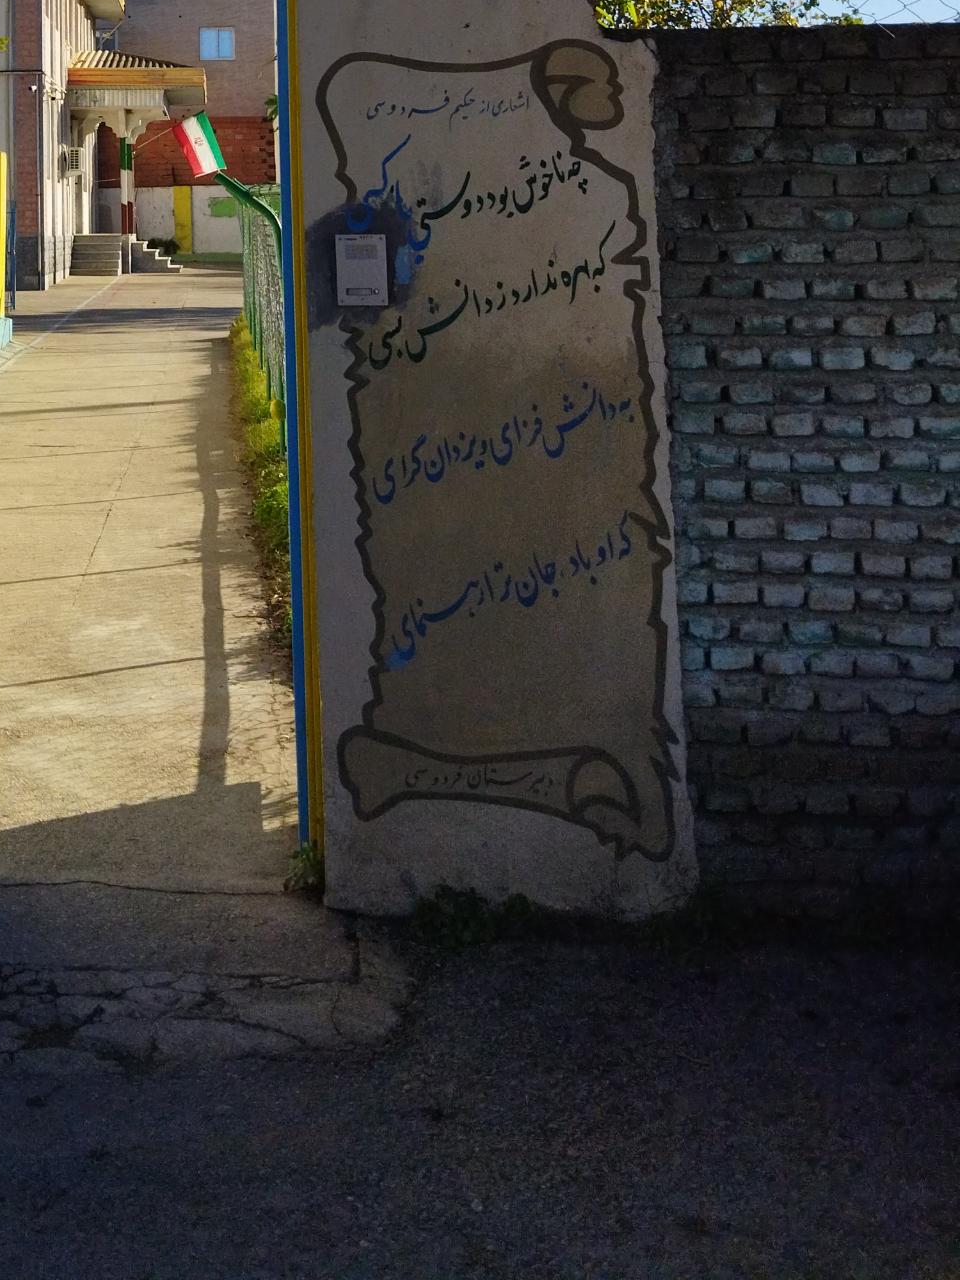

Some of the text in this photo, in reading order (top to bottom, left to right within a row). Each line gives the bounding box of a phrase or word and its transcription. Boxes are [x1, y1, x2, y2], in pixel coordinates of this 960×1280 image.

[367, 88, 530, 129] اشعاری از حکیم فردوسی
[409, 171, 484, 251] دوستی
[487, 185, 516, 218] بود
[368, 220, 617, 370] که بهره ندارد ز دانش بسی
[489, 403, 543, 467] فزای
[543, 380, 617, 460] دانش
[618, 398, 636, 424] به
[596, 531, 614, 567] او
[617, 508, 632, 561] که
[514, 551, 560, 608] جان
[569, 538, 599, 586] باد
[404, 765, 555, 797] دبیرستان فردوسی
